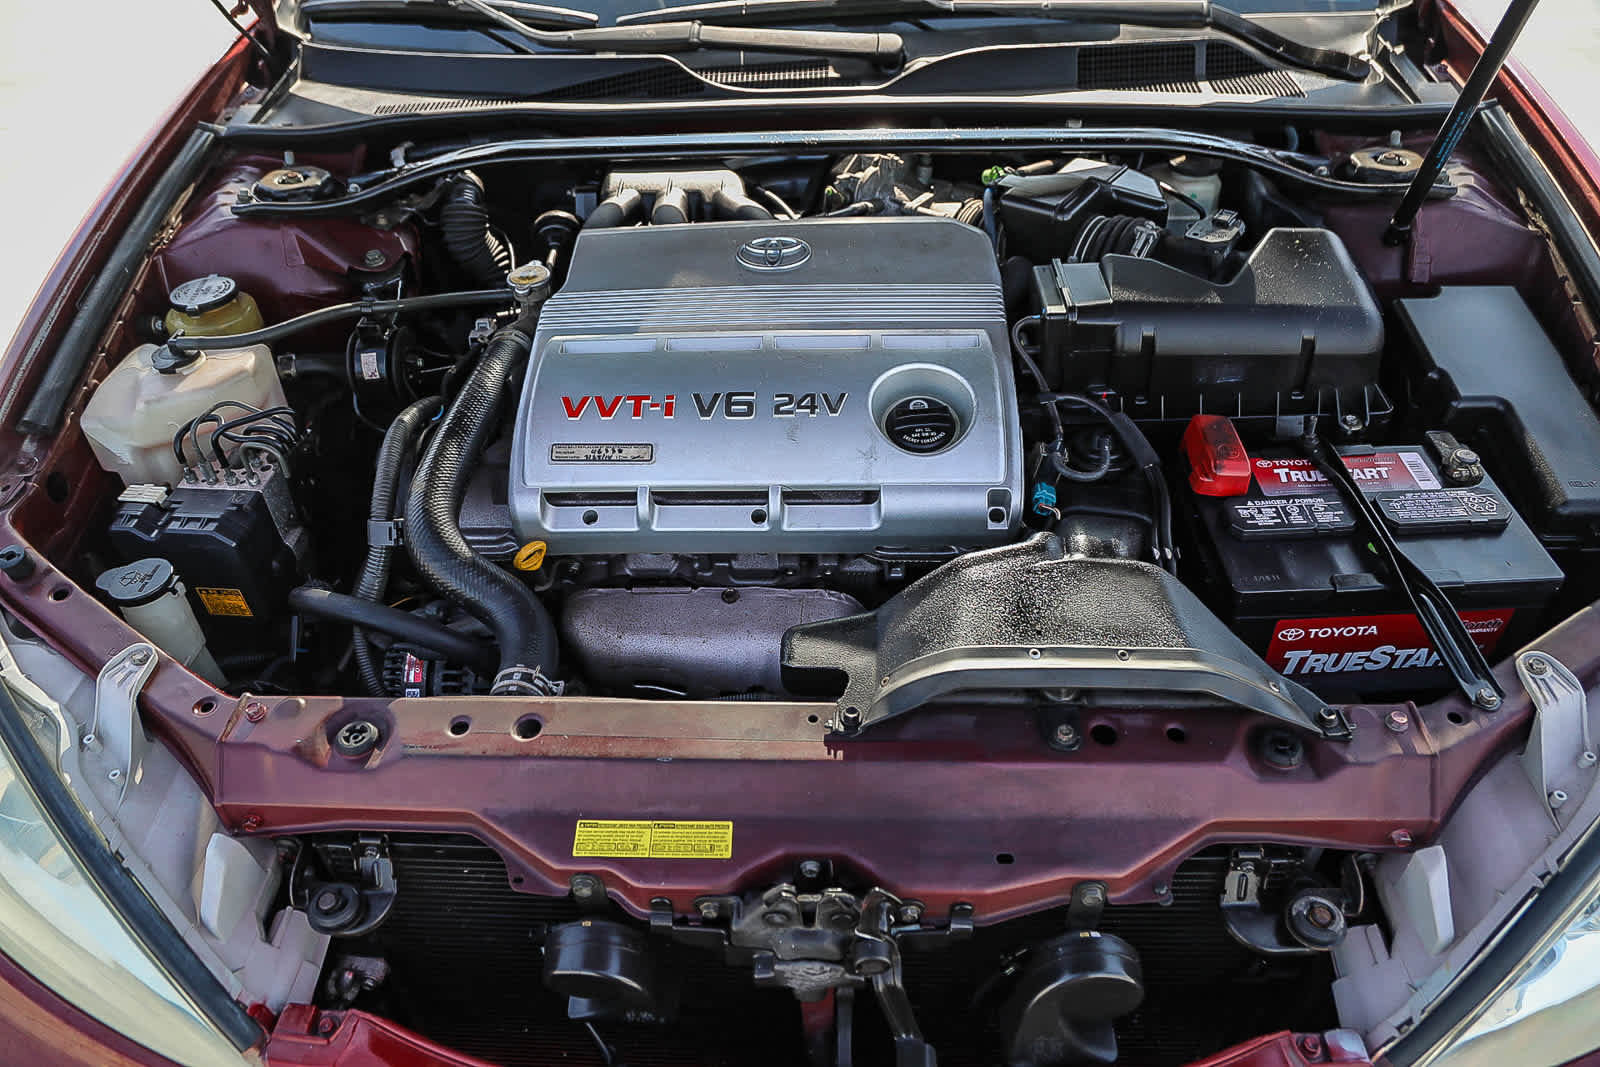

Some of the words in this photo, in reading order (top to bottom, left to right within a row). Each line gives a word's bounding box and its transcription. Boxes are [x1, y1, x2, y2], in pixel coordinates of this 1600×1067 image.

[560, 394, 676, 421] VVT-i
[691, 391, 756, 420] V6
[773, 392, 848, 417] 24V
[1308, 625, 1378, 639] TOYOTA
